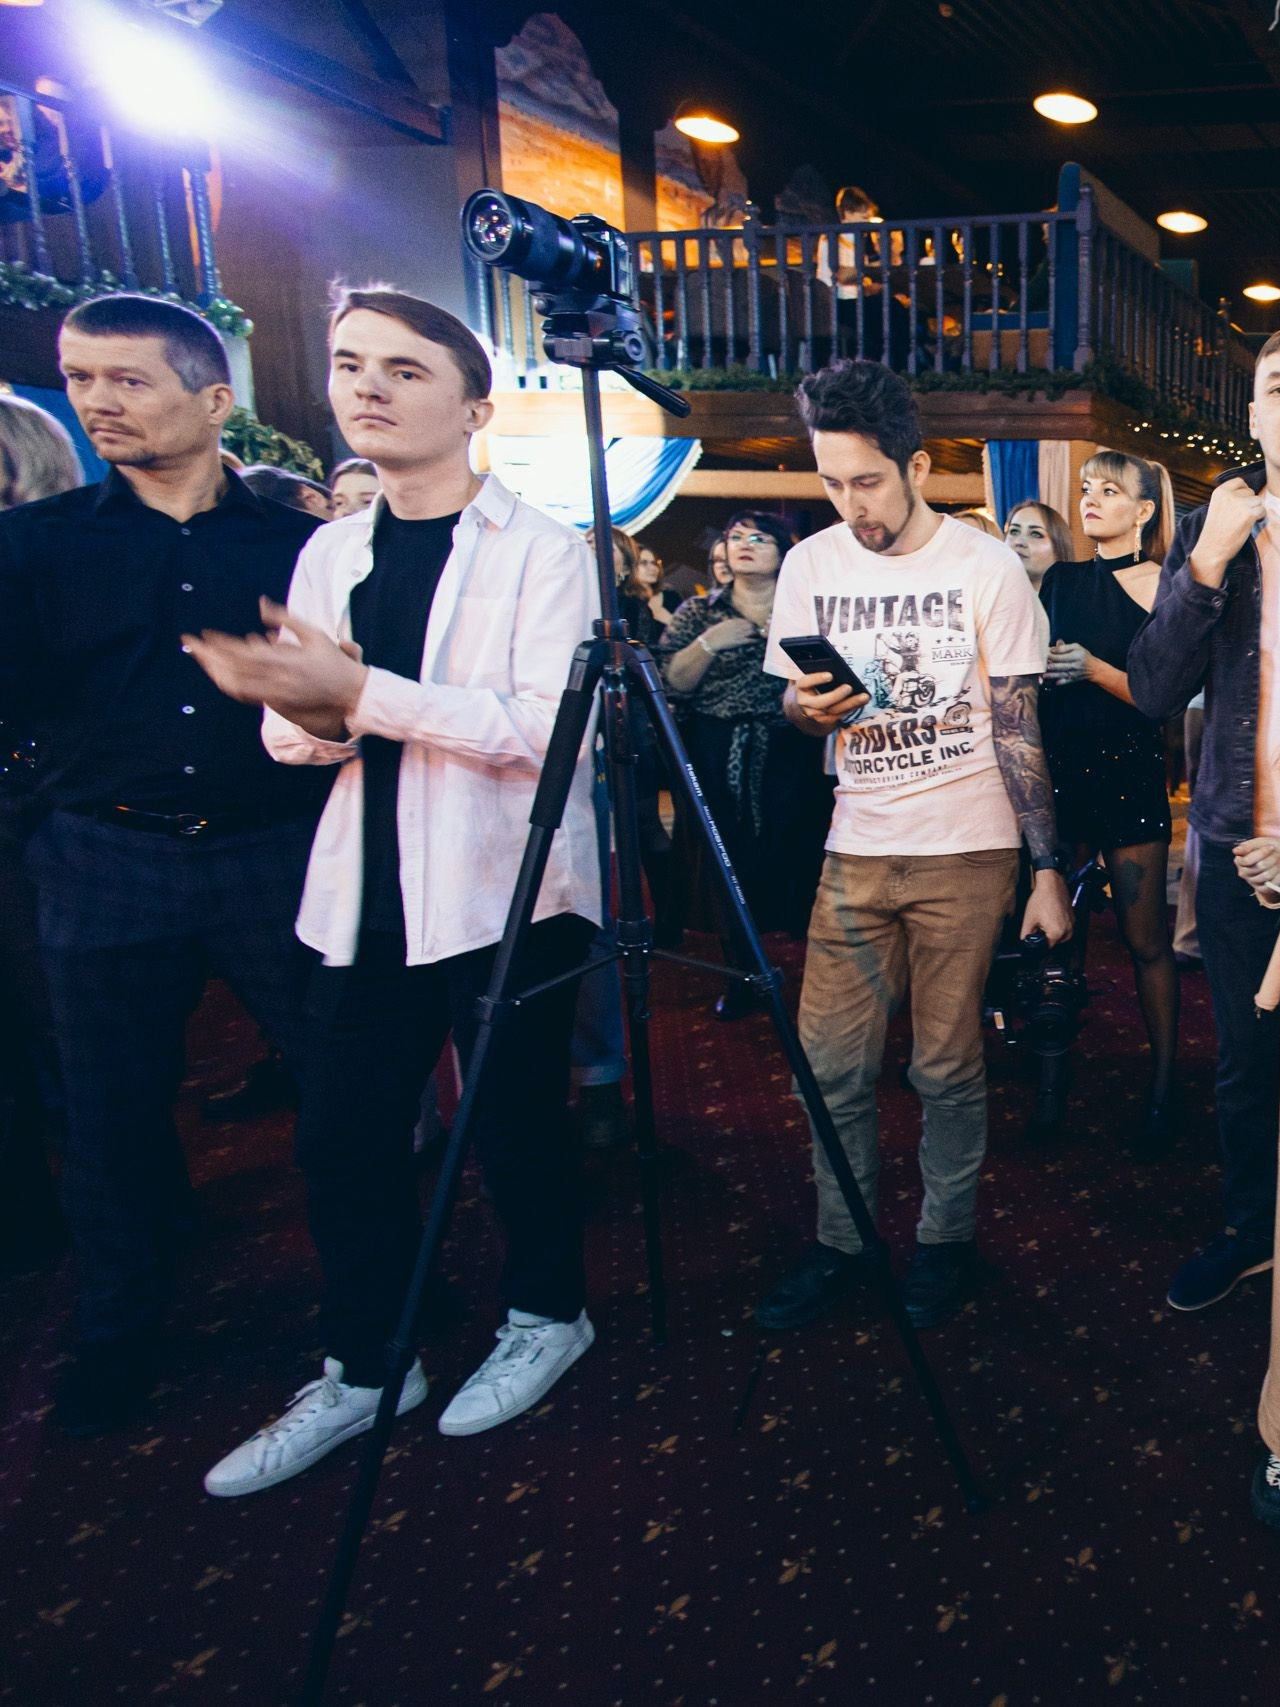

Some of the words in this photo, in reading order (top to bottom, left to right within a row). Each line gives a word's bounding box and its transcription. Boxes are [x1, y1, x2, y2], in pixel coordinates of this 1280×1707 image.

[814, 588, 965, 637] VINTAGE
[931, 647, 974, 661] MARK
[849, 714, 937, 756] RIDERS
[843, 748, 935, 775] TORCYCLE
[940, 741, 974, 761] INC.
[685, 763, 703, 797] Rekam
